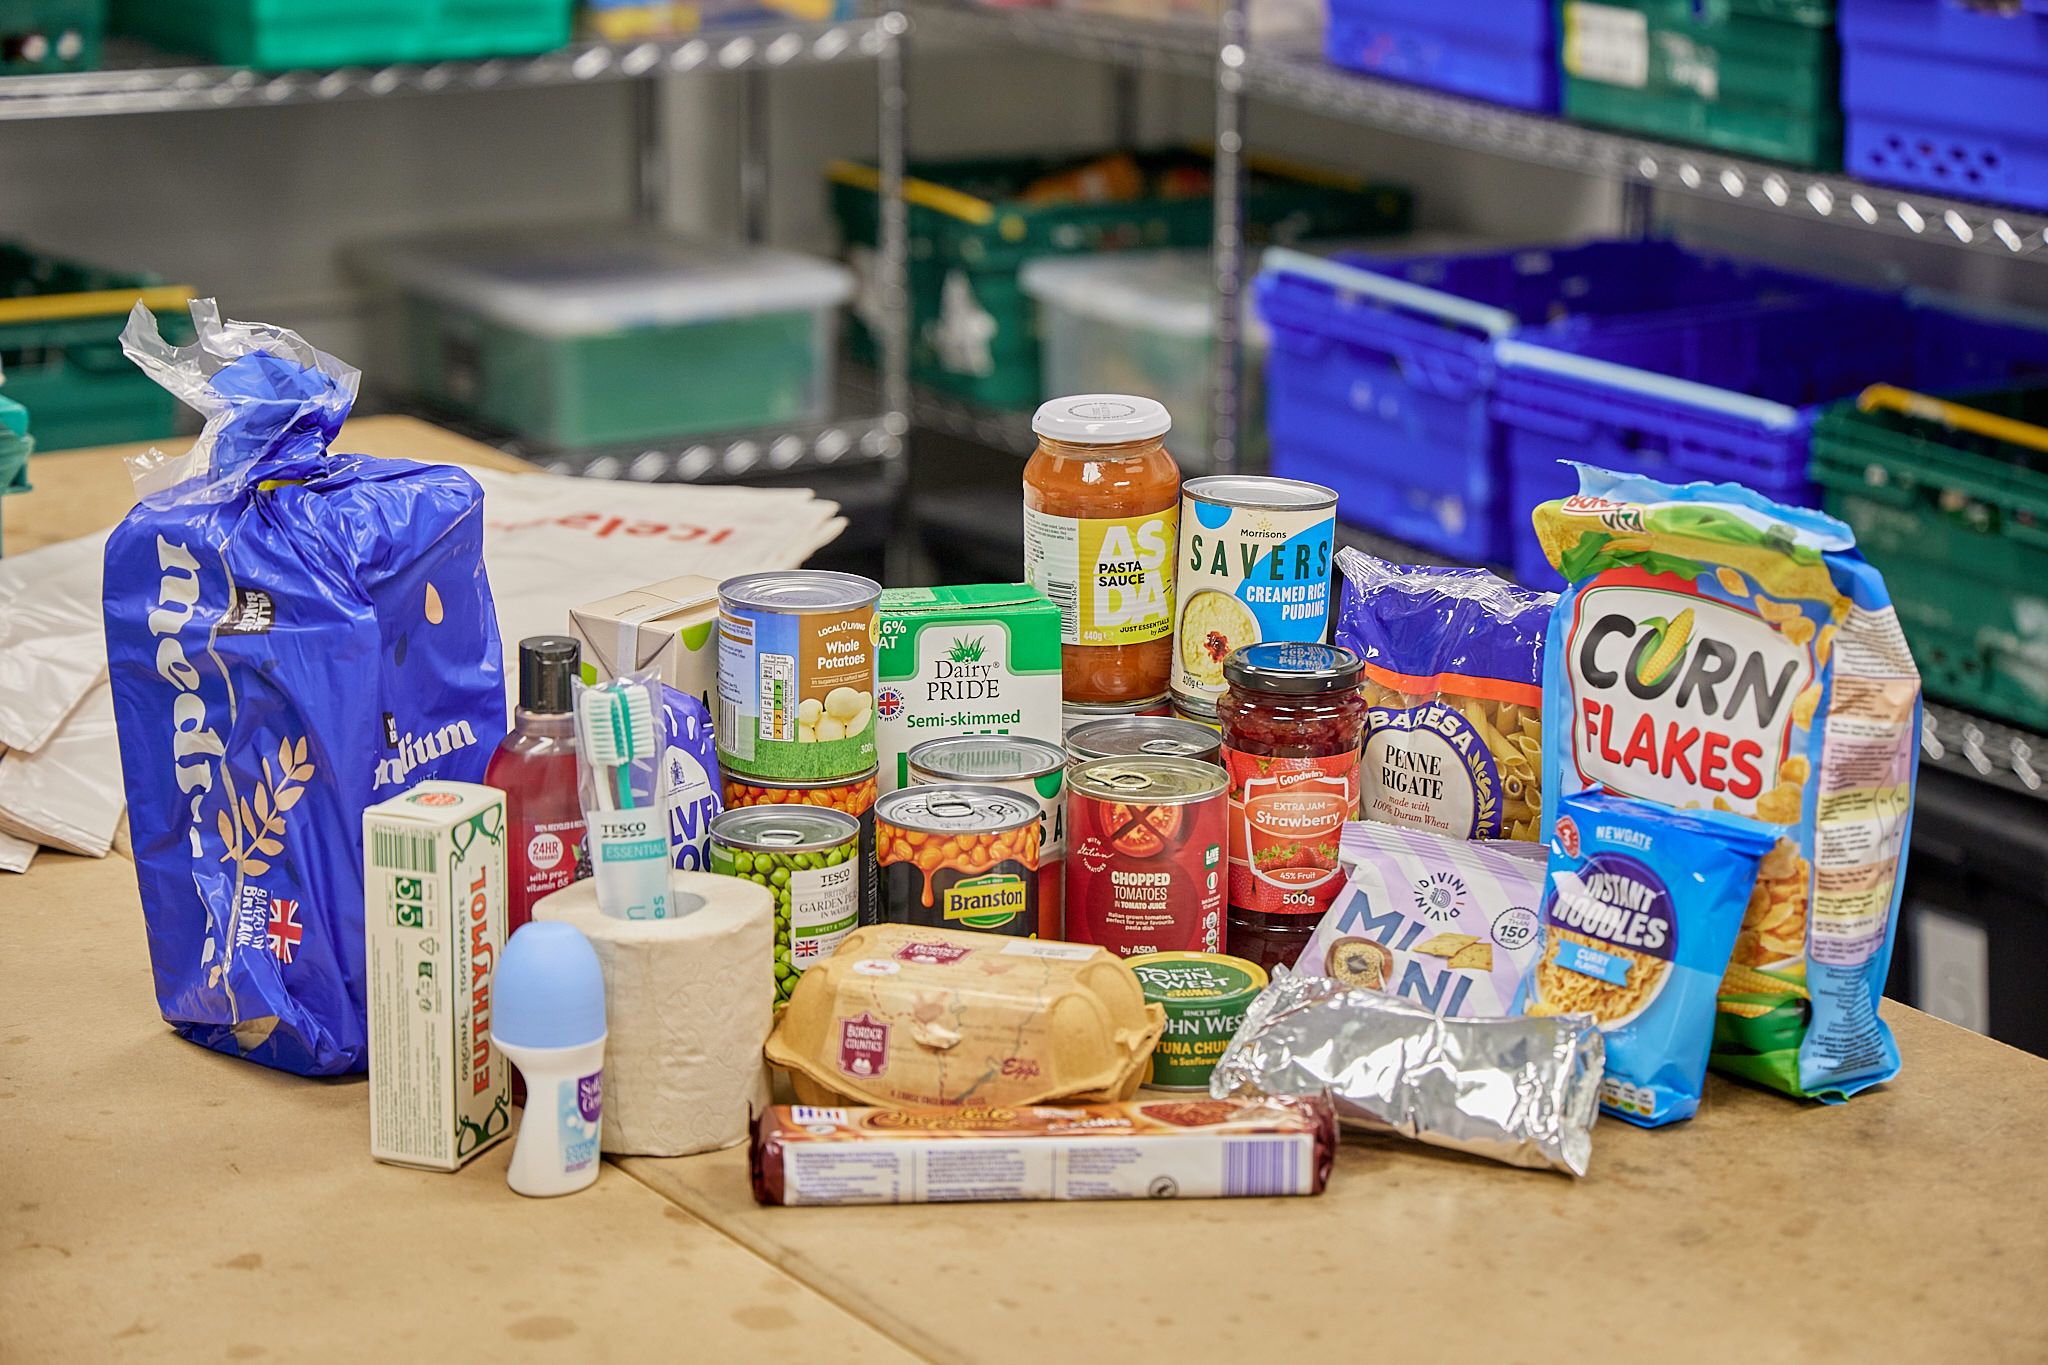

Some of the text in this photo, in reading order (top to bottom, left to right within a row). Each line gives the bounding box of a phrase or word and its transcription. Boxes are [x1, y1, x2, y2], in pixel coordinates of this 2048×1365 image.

[1240, 528, 1287, 539] Morrisons
[1190, 534, 1327, 581] SAVERS
[1098, 561, 1142, 574] PASTA
[1098, 574, 1144, 587] SAUCE
[1246, 582, 1325, 602] CREAMED RICE
[1281, 600, 1324, 621] PUDDING
[817, 621, 866, 638] LOCAL LIVING
[879, 620, 906, 635] .6%
[1119, 617, 1170, 633] JUST ESSENTIALS
[1157, 625, 1169, 635] ASDA
[879, 636, 898, 649] AT
[1083, 631, 1103, 642] 440g
[826, 638, 860, 655] Whole
[817, 653, 865, 670] Potatoes
[934, 660, 993, 683] Dairy
[1580, 613, 1799, 729] CORN
[926, 679, 1000, 701] PRIDE
[907, 709, 1021, 728] Semi-skimmed
[1368, 706, 1475, 756] BARESA
[1582, 697, 1763, 800] FLAKES
[1384, 744, 1441, 776] PENNE
[1279, 770, 1323, 786] Goodwin's
[1382, 766, 1443, 800] RIGATE
[1273, 801, 1326, 811] EXTRA JAM
[1388, 794, 1430, 813] made with
[1255, 810, 1340, 828] Strawberry
[1372, 798, 1450, 830] 100% Durum Wheat
[601, 821, 647, 834] TESCO
[1595, 825, 1653, 851] NEWGATE
[532, 841, 559, 855] 24HR
[820, 868, 850, 885] TESCO
[1111, 871, 1171, 886] CHOPPED
[1279, 871, 1316, 880] 45% Fruit
[1113, 886, 1168, 901] TOMATOES
[1282, 893, 1316, 906] 500g
[1584, 872, 1657, 911] INSTANT
[799, 895, 844, 913] GARDEN
[949, 890, 1023, 912] Branston
[1120, 901, 1147, 909] TOMATO
[1147, 902, 1167, 910] JUICE
[820, 905, 850, 919] IN WATER
[1511, 912, 1531, 921] LESS
[1508, 918, 1530, 927] THAN
[1551, 893, 1668, 949] NOODLES
[1499, 925, 1529, 939] 150
[1500, 938, 1521, 946] KCAL
[1120, 946, 1158, 955] by ASDA
[471, 865, 495, 1097] EUTHYMOL
[1138, 970, 1213, 984] JOHN
[1158, 977, 1230, 990] WEST
[1204, 1013, 1246, 1035] WES
[1156, 1041, 1192, 1055] TUNA
